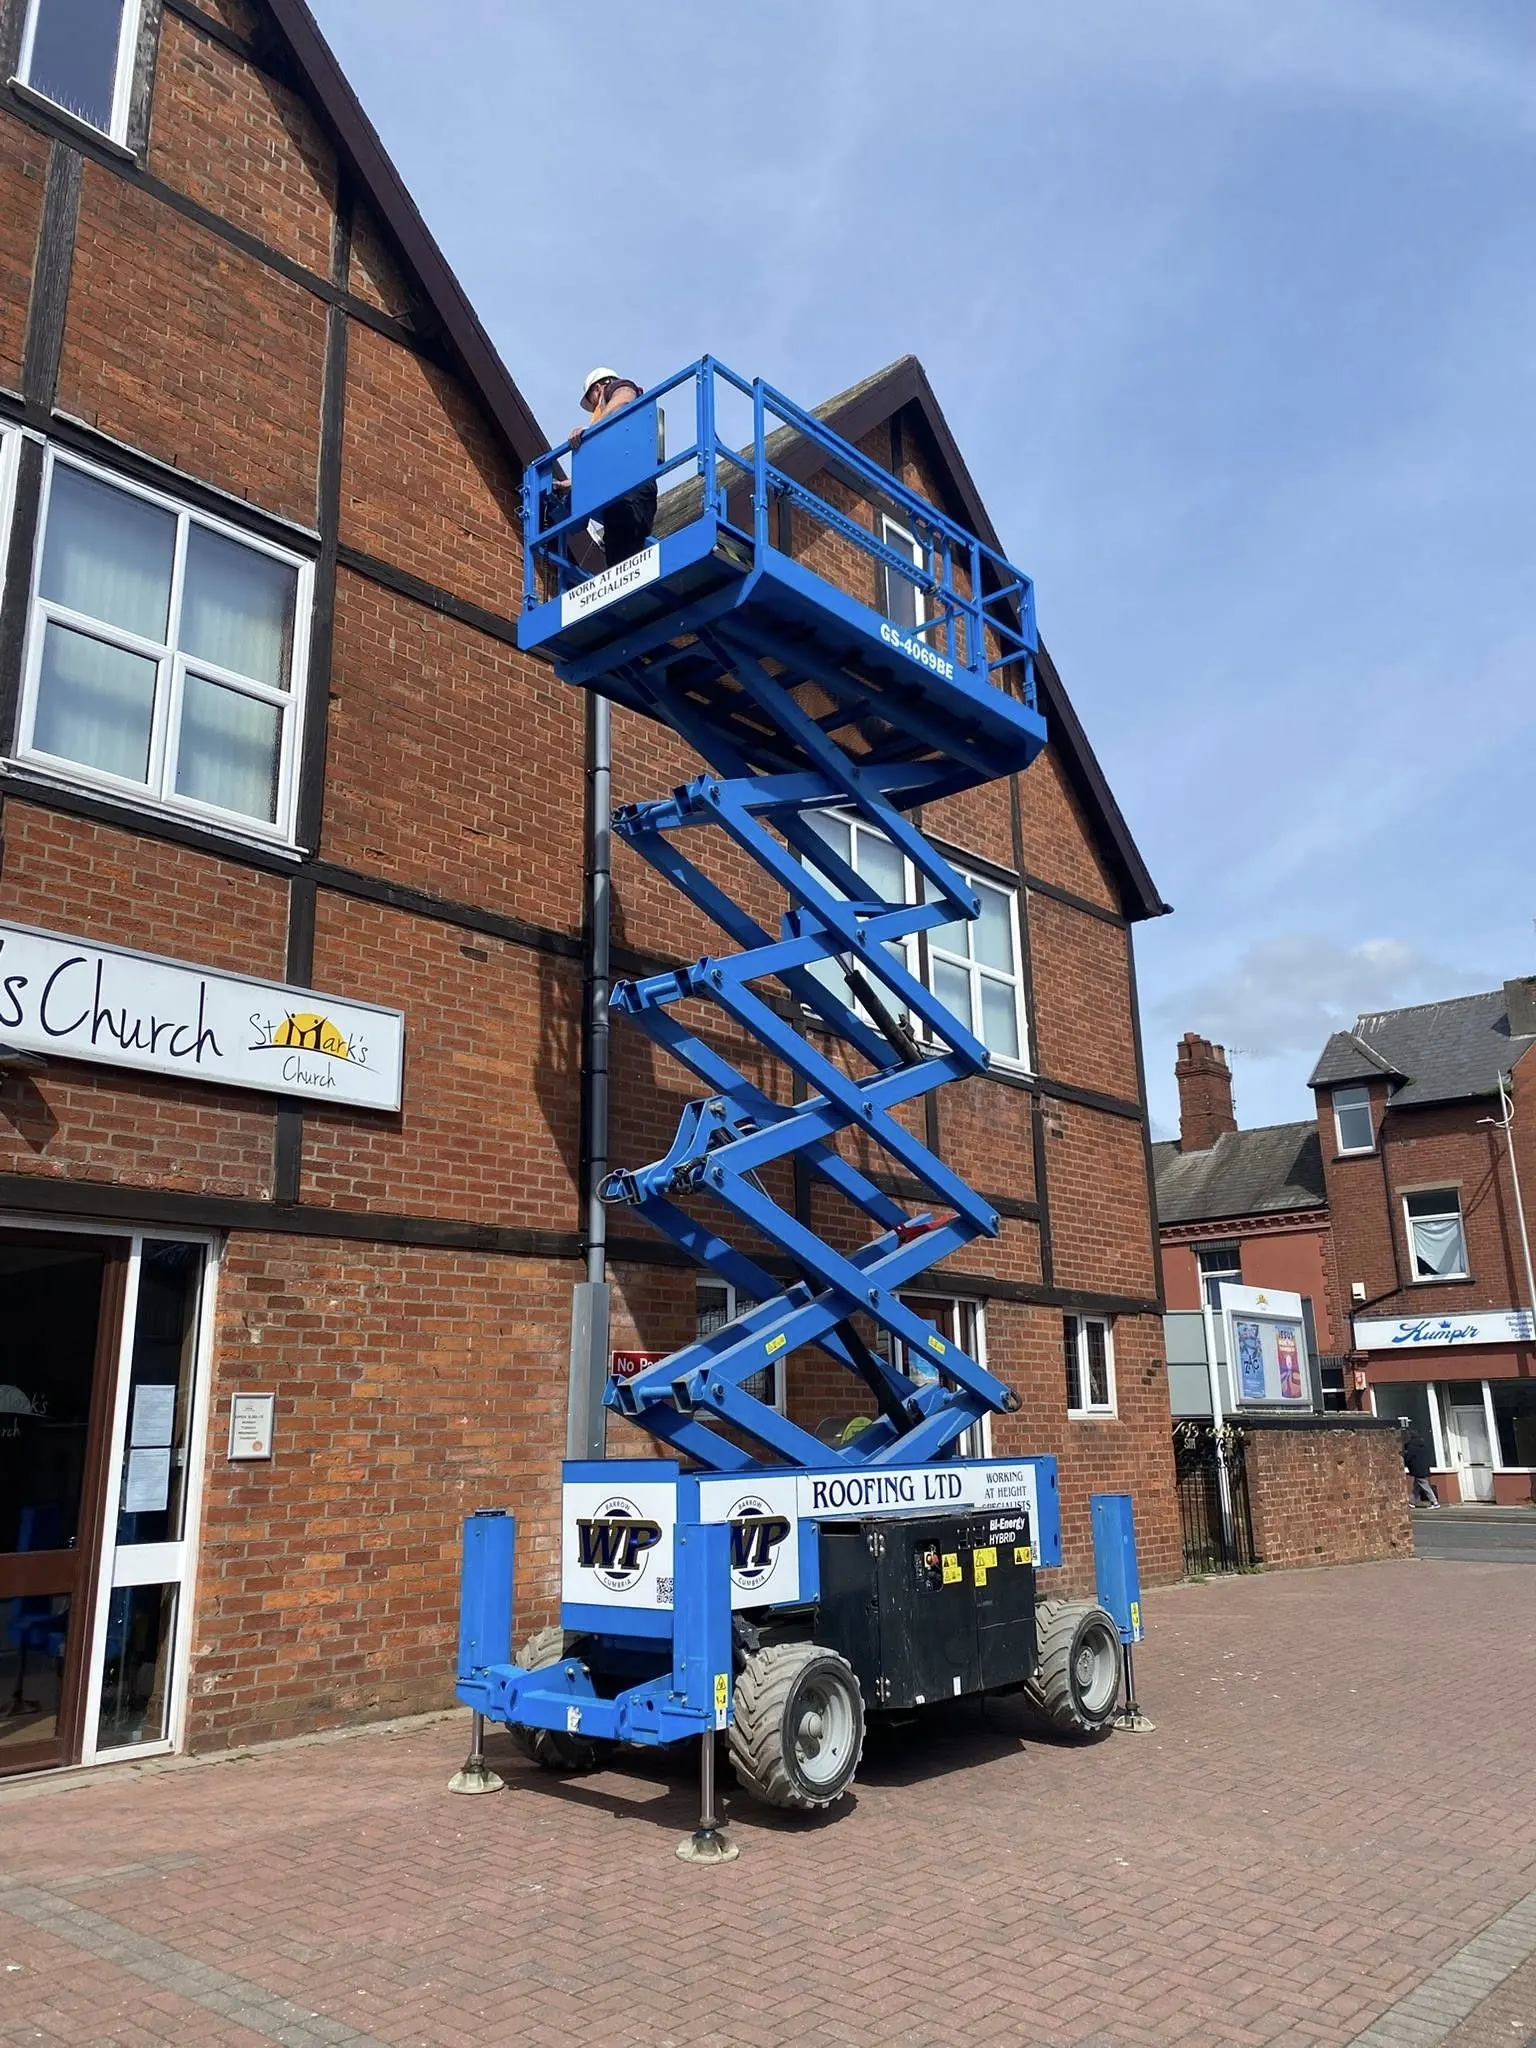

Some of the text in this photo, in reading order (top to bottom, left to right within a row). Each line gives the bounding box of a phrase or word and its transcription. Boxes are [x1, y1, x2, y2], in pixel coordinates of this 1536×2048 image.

[568, 548, 653, 601] WORK AT HEIGHT
[580, 568, 641, 608] SPECIALISTS
[880, 623, 954, 680] GS-4069BE
[40, 956, 223, 1063] Church
[283, 1007, 368, 1063] Mark's
[282, 1055, 336, 1088] Church
[617, 1358, 634, 1372] No
[813, 1473, 962, 1509] ROOFING LTD
[985, 1486, 1027, 1499] AT HEIGHT
[986, 1471, 1023, 1484] WORKING
[576, 1518, 662, 1570] WP
[989, 1531, 1016, 1545] HYBRID
